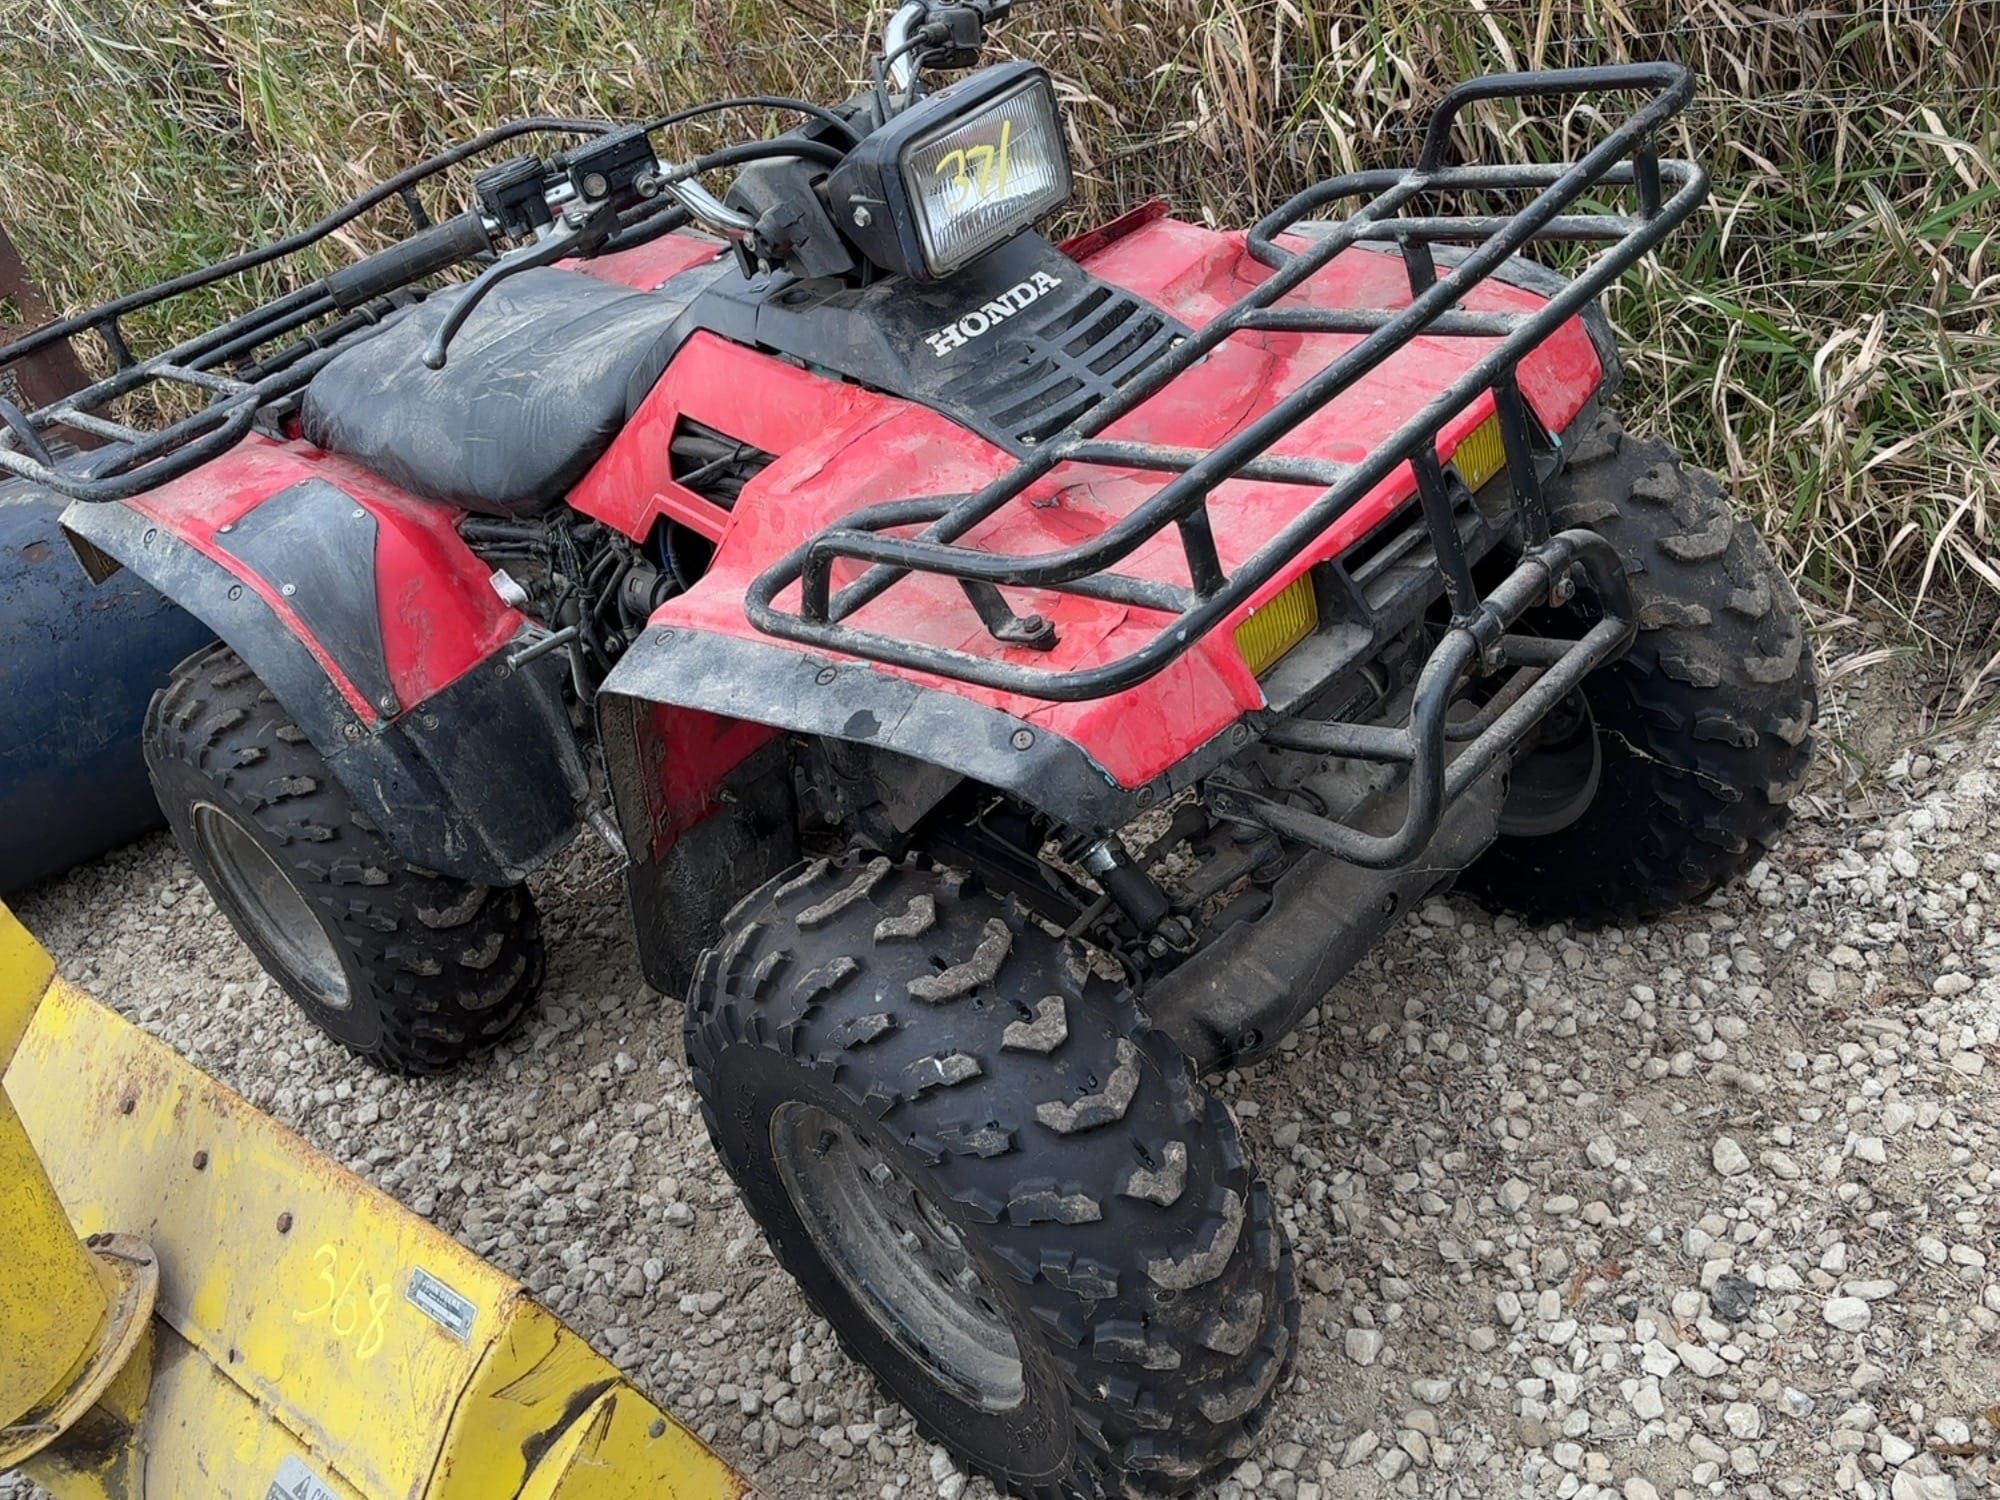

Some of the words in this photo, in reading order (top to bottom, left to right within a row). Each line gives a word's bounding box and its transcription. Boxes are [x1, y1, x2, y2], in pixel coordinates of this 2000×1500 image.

[935, 119, 1010, 209] 371
[925, 270, 1062, 357] HONDA
[293, 1243, 392, 1359] 368
